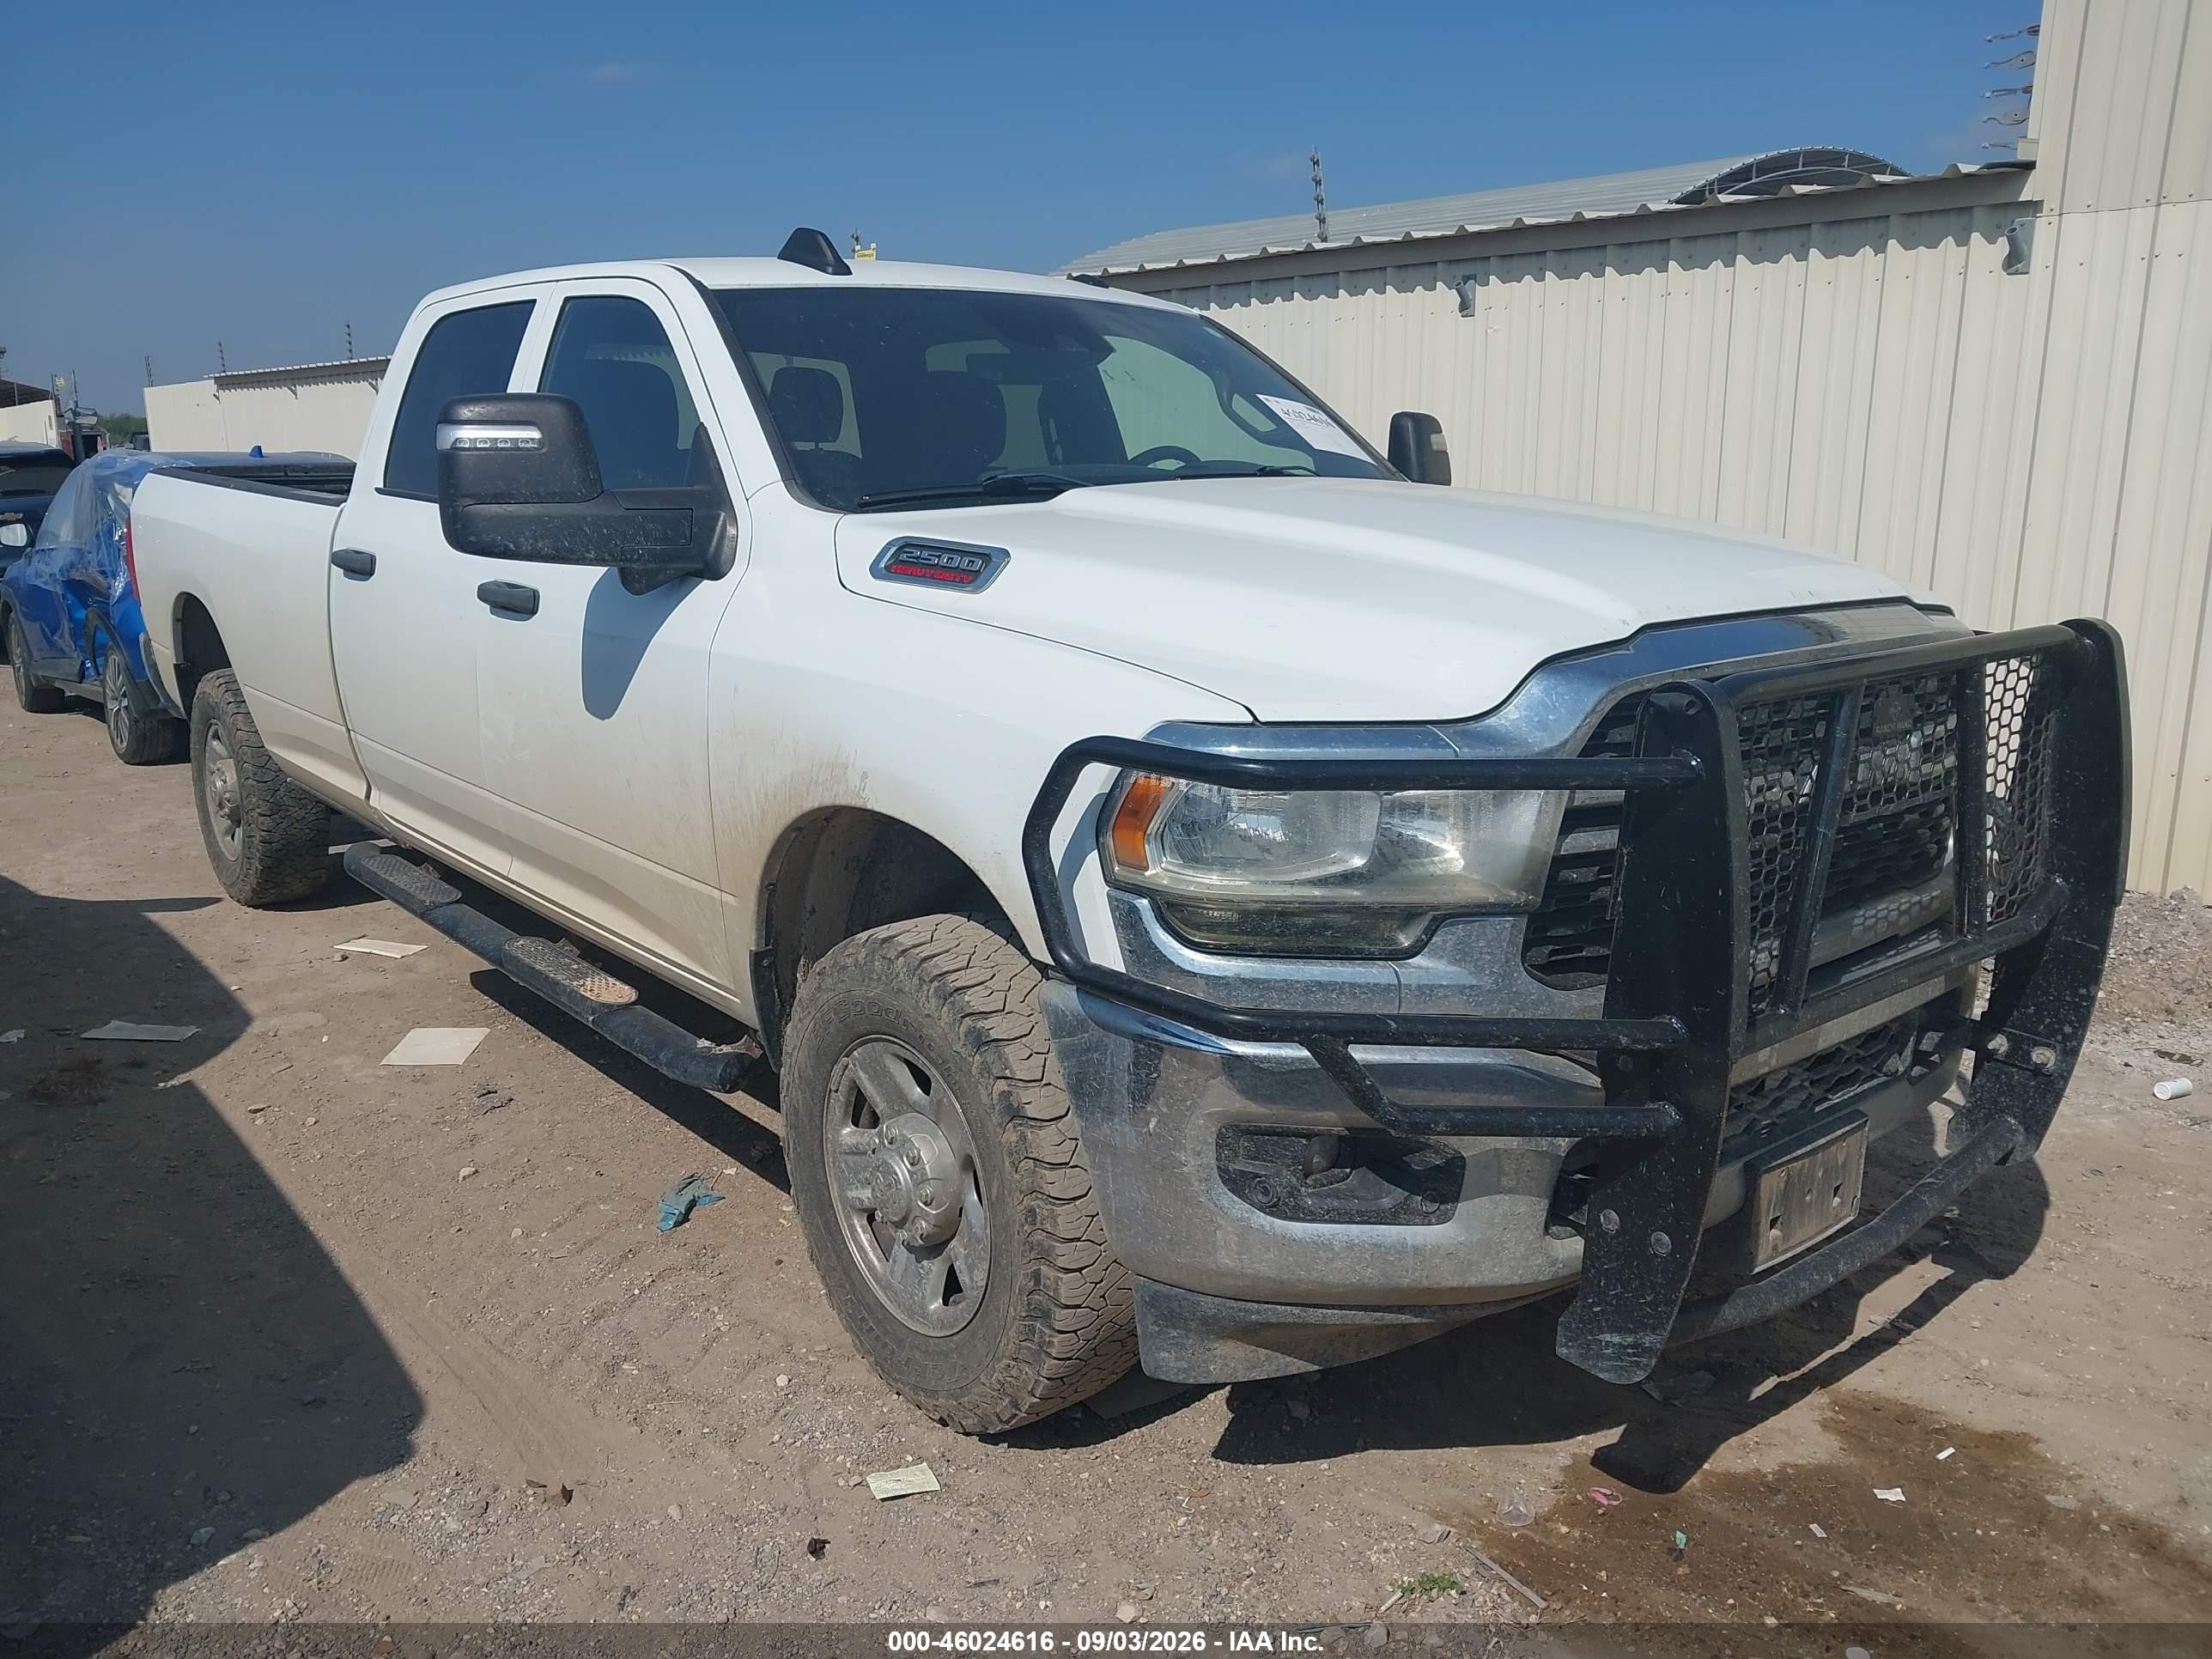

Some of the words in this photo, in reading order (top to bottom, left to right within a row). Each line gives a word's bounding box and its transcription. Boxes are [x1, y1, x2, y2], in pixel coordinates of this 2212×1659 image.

[898, 549, 983, 572] 2500
[890, 564, 934, 578] HEAVY
[934, 570, 974, 584] DUTY
